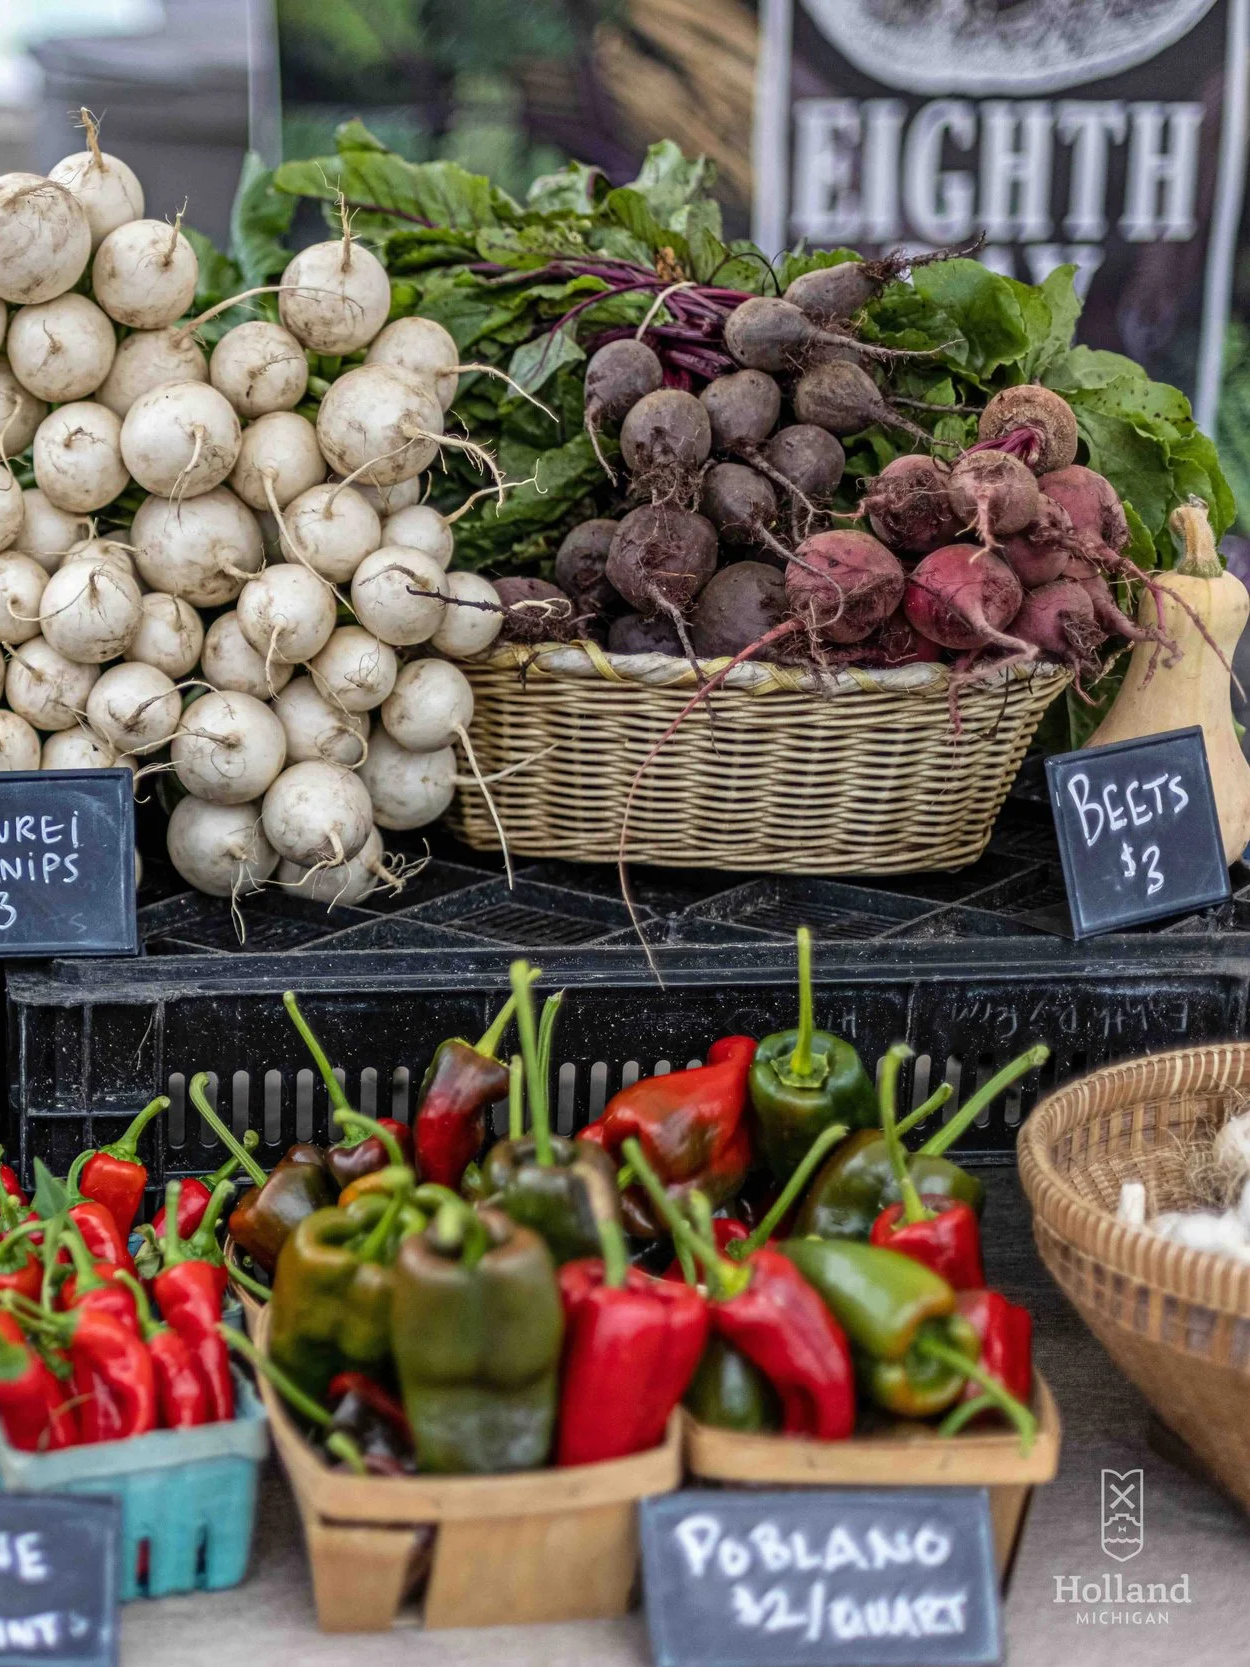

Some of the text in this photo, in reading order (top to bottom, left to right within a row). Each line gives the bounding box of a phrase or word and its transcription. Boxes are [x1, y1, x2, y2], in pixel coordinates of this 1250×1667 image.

[791, 99, 1205, 244] EIGHTH
[1067, 772, 1190, 847] BEETS
[1120, 842, 1165, 895] $3
